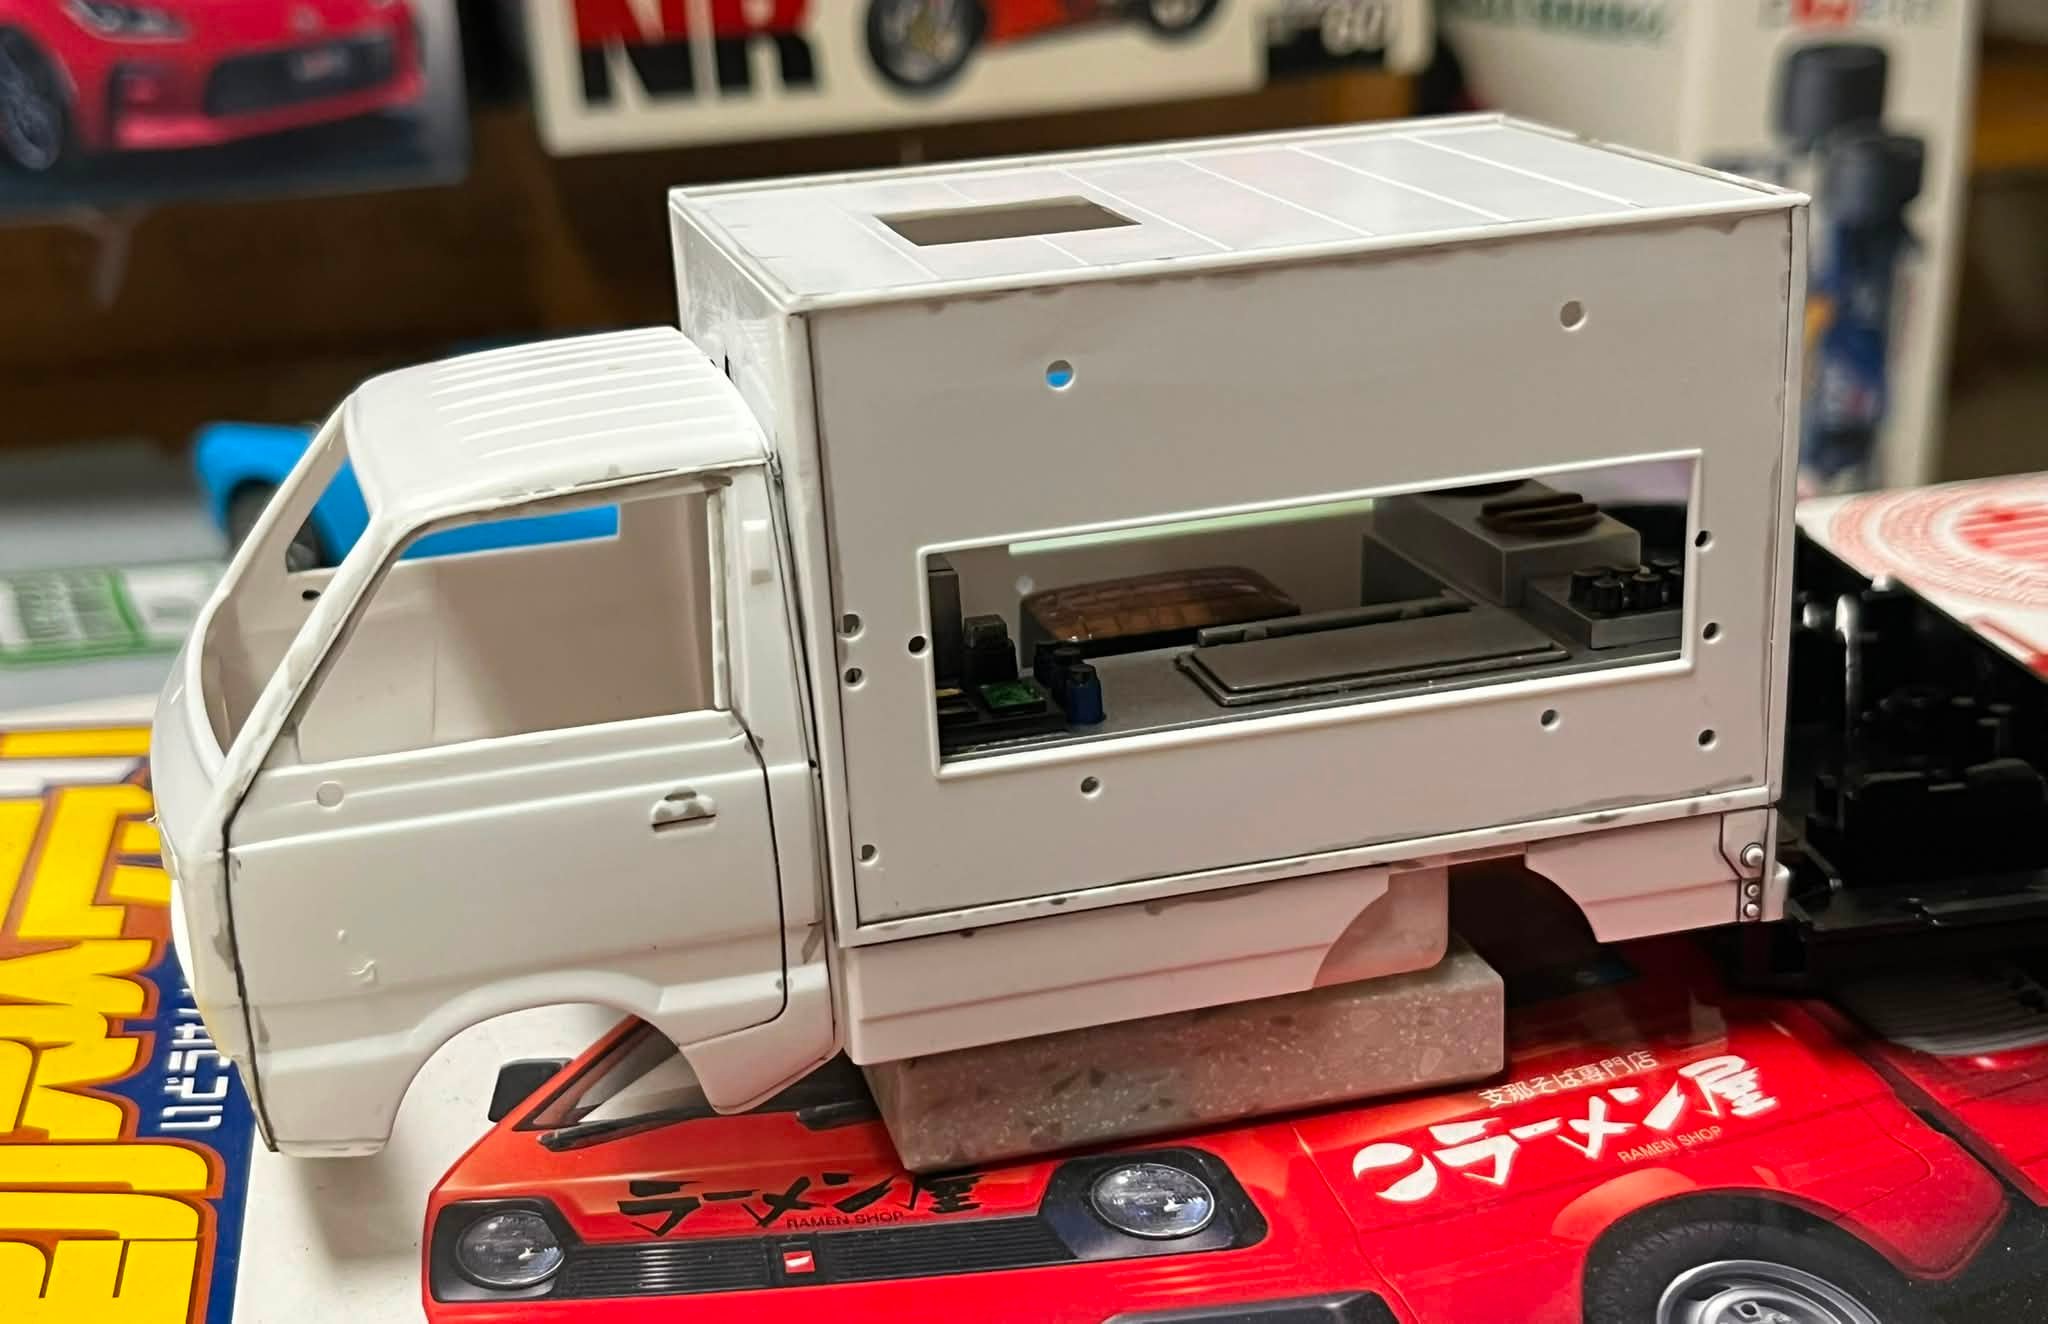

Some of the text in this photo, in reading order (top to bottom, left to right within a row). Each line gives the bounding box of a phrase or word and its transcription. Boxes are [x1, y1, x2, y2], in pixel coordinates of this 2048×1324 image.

[1428, 1055, 1777, 1186] ラーメン屋
[1617, 1125, 1722, 1164] RAMEN SHOP
[785, 1210, 904, 1229] RAMEN SHOP
